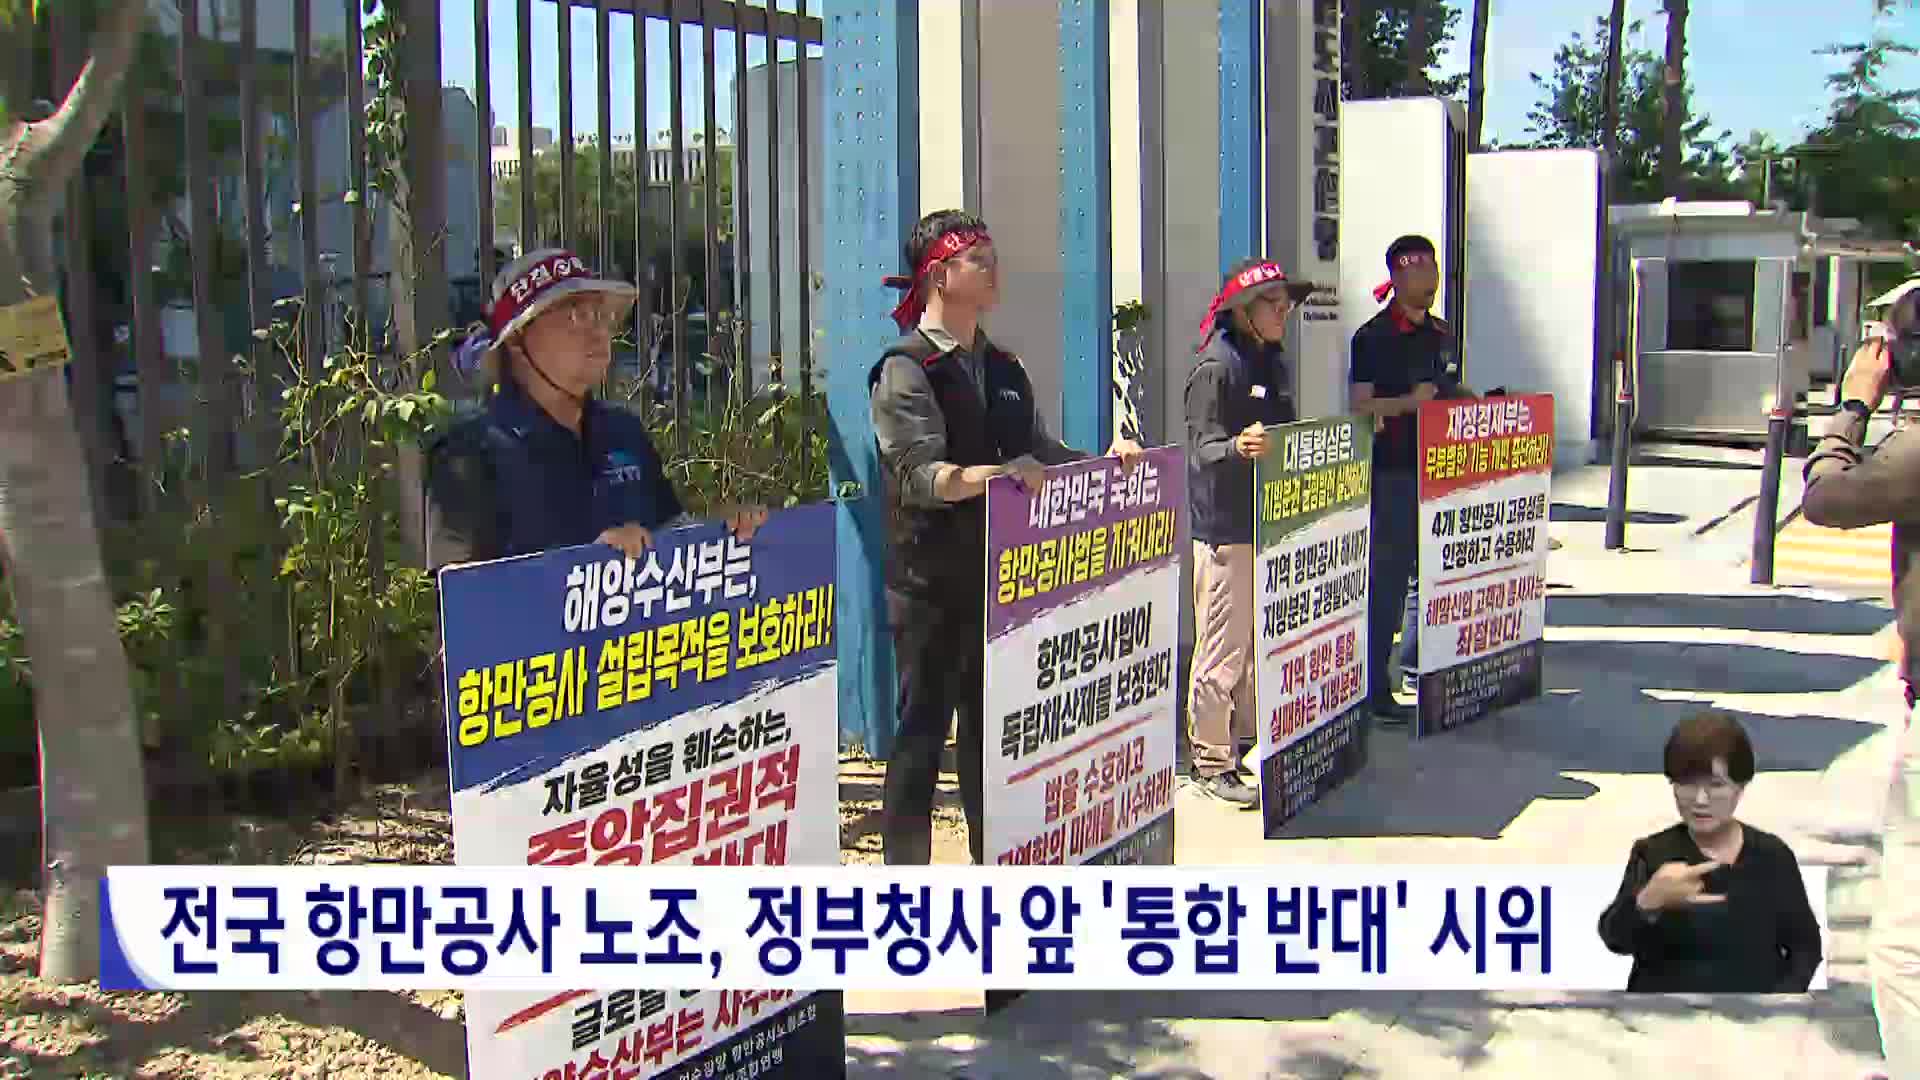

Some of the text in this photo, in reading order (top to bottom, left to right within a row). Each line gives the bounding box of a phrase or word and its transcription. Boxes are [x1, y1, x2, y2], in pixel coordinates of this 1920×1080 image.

[1283, 423, 1354, 472] 대통령실은,
[1446, 400, 1533, 441] 재정경제부는,
[1028, 469, 1107, 528] 대한민국
[1432, 509, 1456, 537] 4개
[1459, 500, 1505, 534] 항만공사
[997, 508, 1177, 604] 항만공사법을 지켜내라!
[1265, 552, 1291, 593] 지역
[1295, 536, 1338, 584] 항만공사
[1442, 526, 1535, 570] 인정하고 수용하라
[564, 536, 758, 633] 해양수산부는,
[1263, 589, 1310, 639] 지방분권
[458, 584, 835, 747] 항만공사 설립목적을 보호하라!
[1037, 601, 1152, 690] 항만공사법이
[1115, 648, 1170, 712] 보장한다
[542, 709, 792, 816] 자율성을 훼손하는,
[1045, 736, 1145, 824] 법을 수호하고
[527, 744, 798, 865] 중앙집권적
